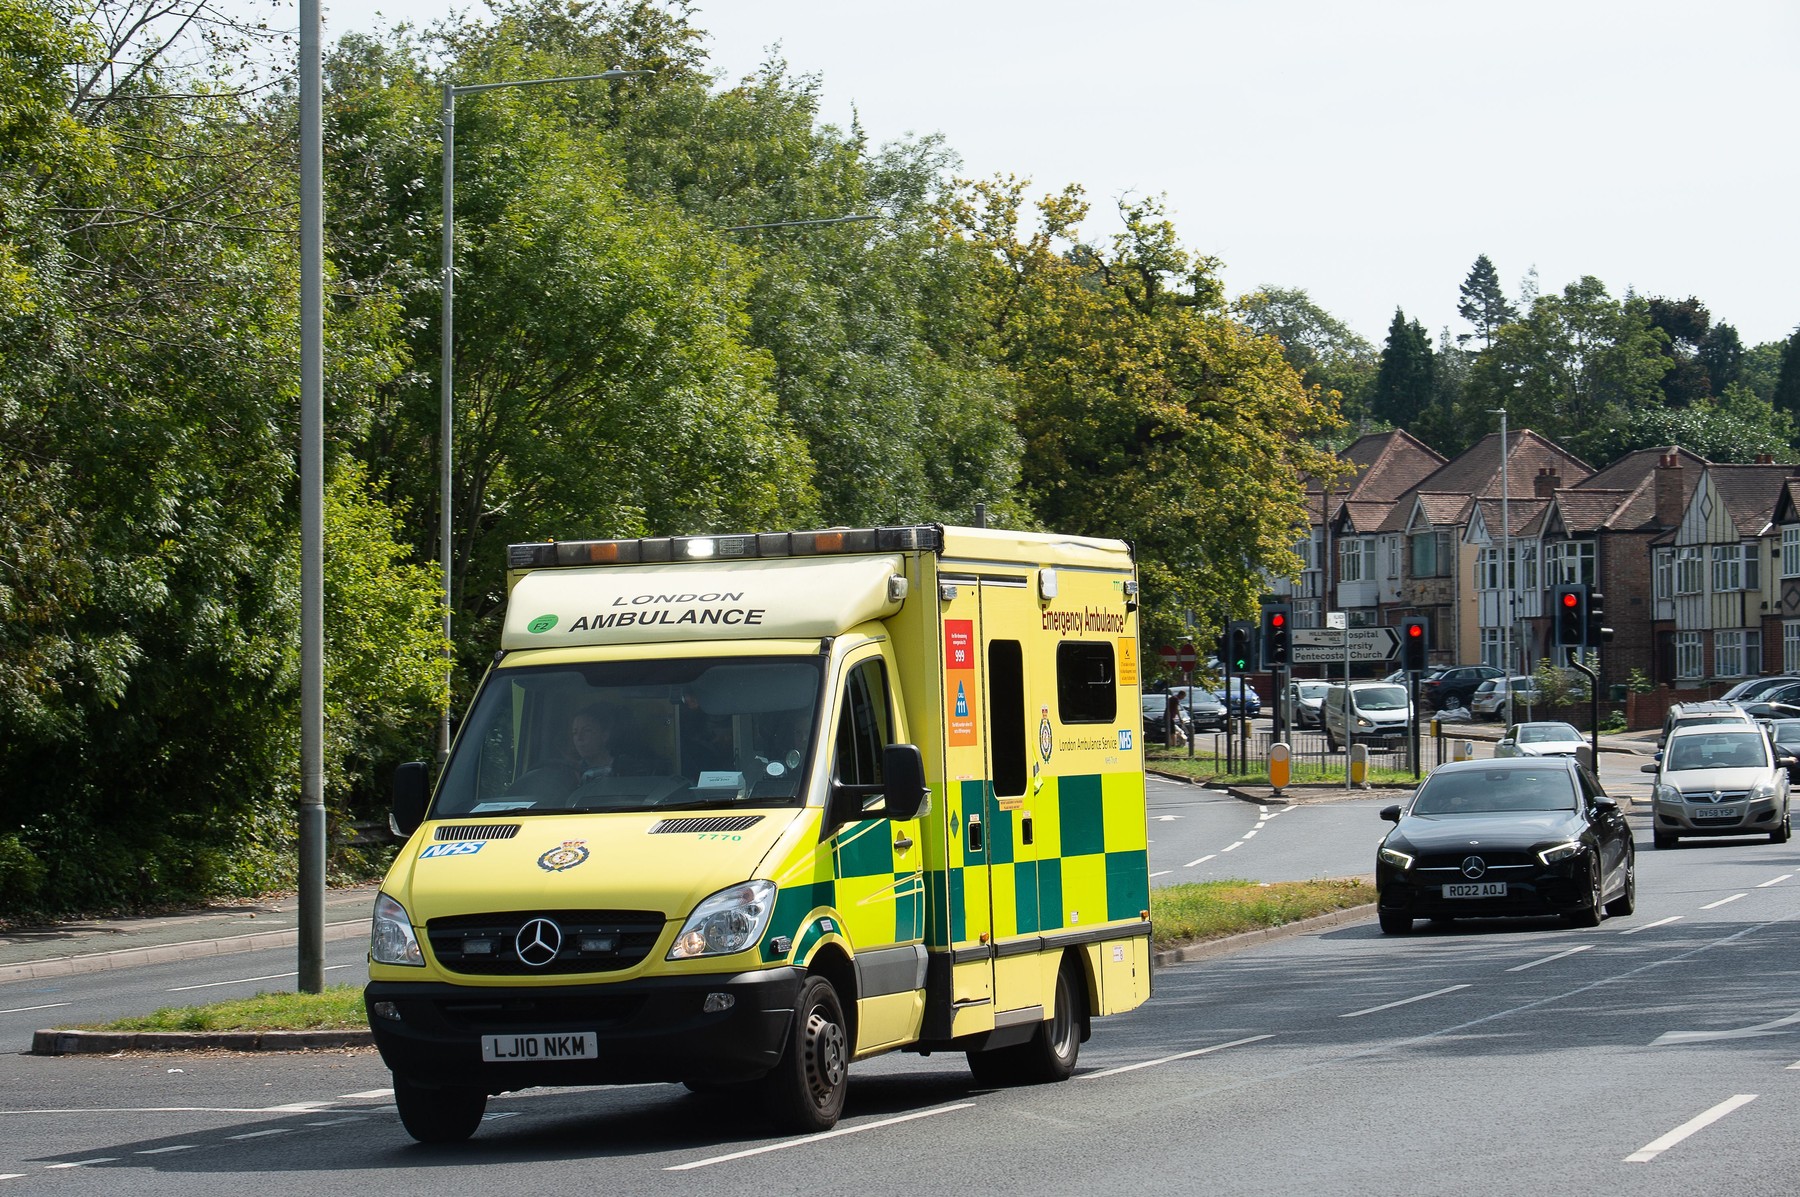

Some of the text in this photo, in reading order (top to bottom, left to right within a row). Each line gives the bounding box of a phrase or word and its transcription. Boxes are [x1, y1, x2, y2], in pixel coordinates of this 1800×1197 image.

[612, 592, 744, 606] LONDON
[533, 622, 548, 630] F2
[568, 609, 766, 632] AMBULANCE
[1042, 604, 1123, 636] Emergency Ambulance
[955, 650, 964, 662] 999
[1295, 651, 1382, 661] Pentecosta Church
[957, 701, 966, 713] 111
[1059, 737, 1117, 751] London Ambulance Service
[1119, 731, 1132, 749] NHS
[422, 842, 481, 857] NHS
[1449, 884, 1505, 896] RO22 AOJ
[494, 1036, 585, 1057] LJ10 NKM
